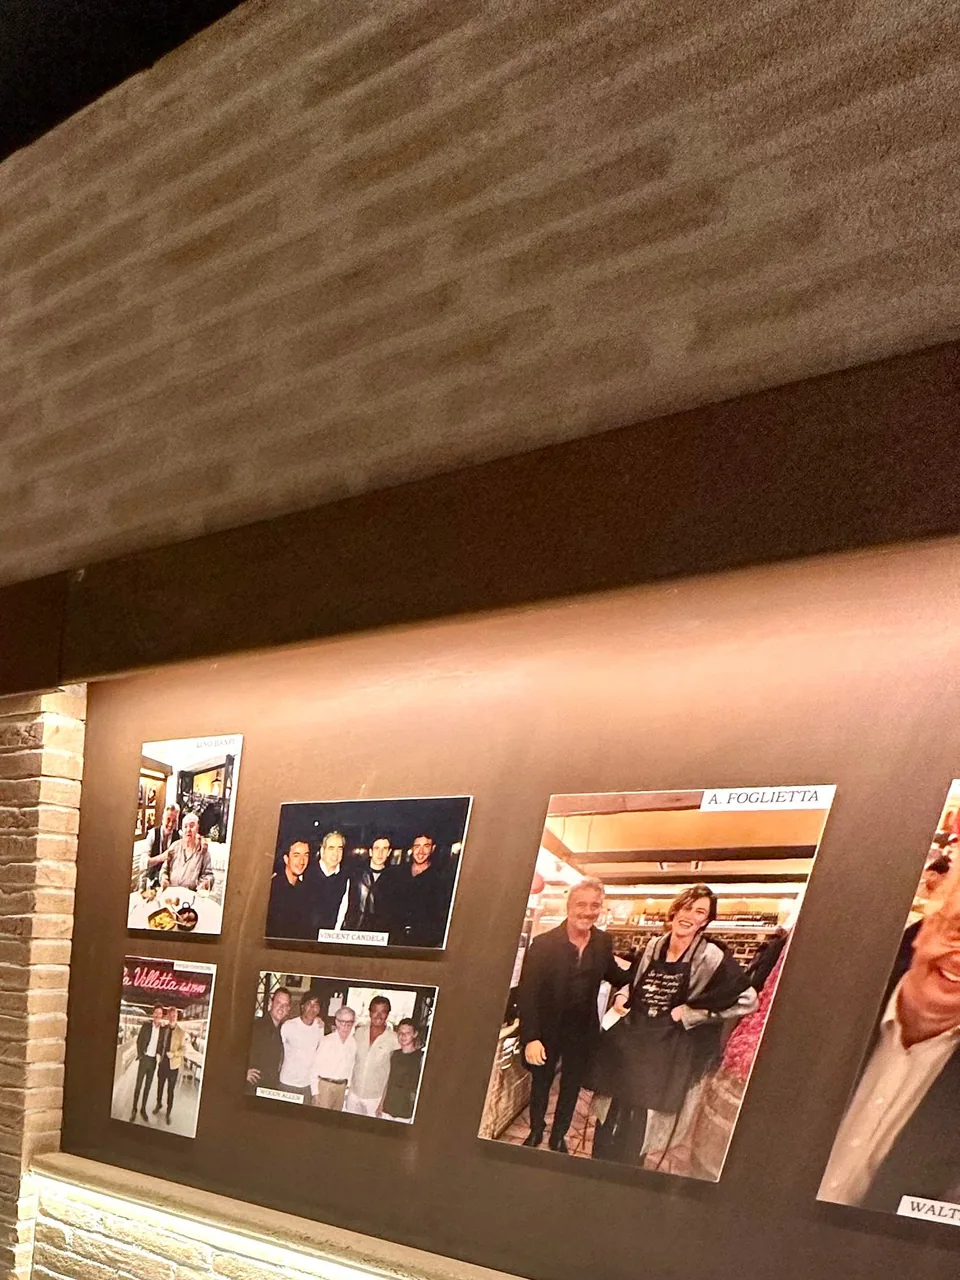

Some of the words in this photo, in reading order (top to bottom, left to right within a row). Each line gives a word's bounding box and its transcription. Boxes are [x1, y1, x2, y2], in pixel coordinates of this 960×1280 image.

[708, 793, 722, 805] A.
[727, 790, 819, 804] FOGLIETTA
[320, 932, 350, 940] VINCENT
[351, 934, 385, 942] CANDELA
[134, 967, 178, 990] Villetta
[911, 1201, 960, 1221] WALT
